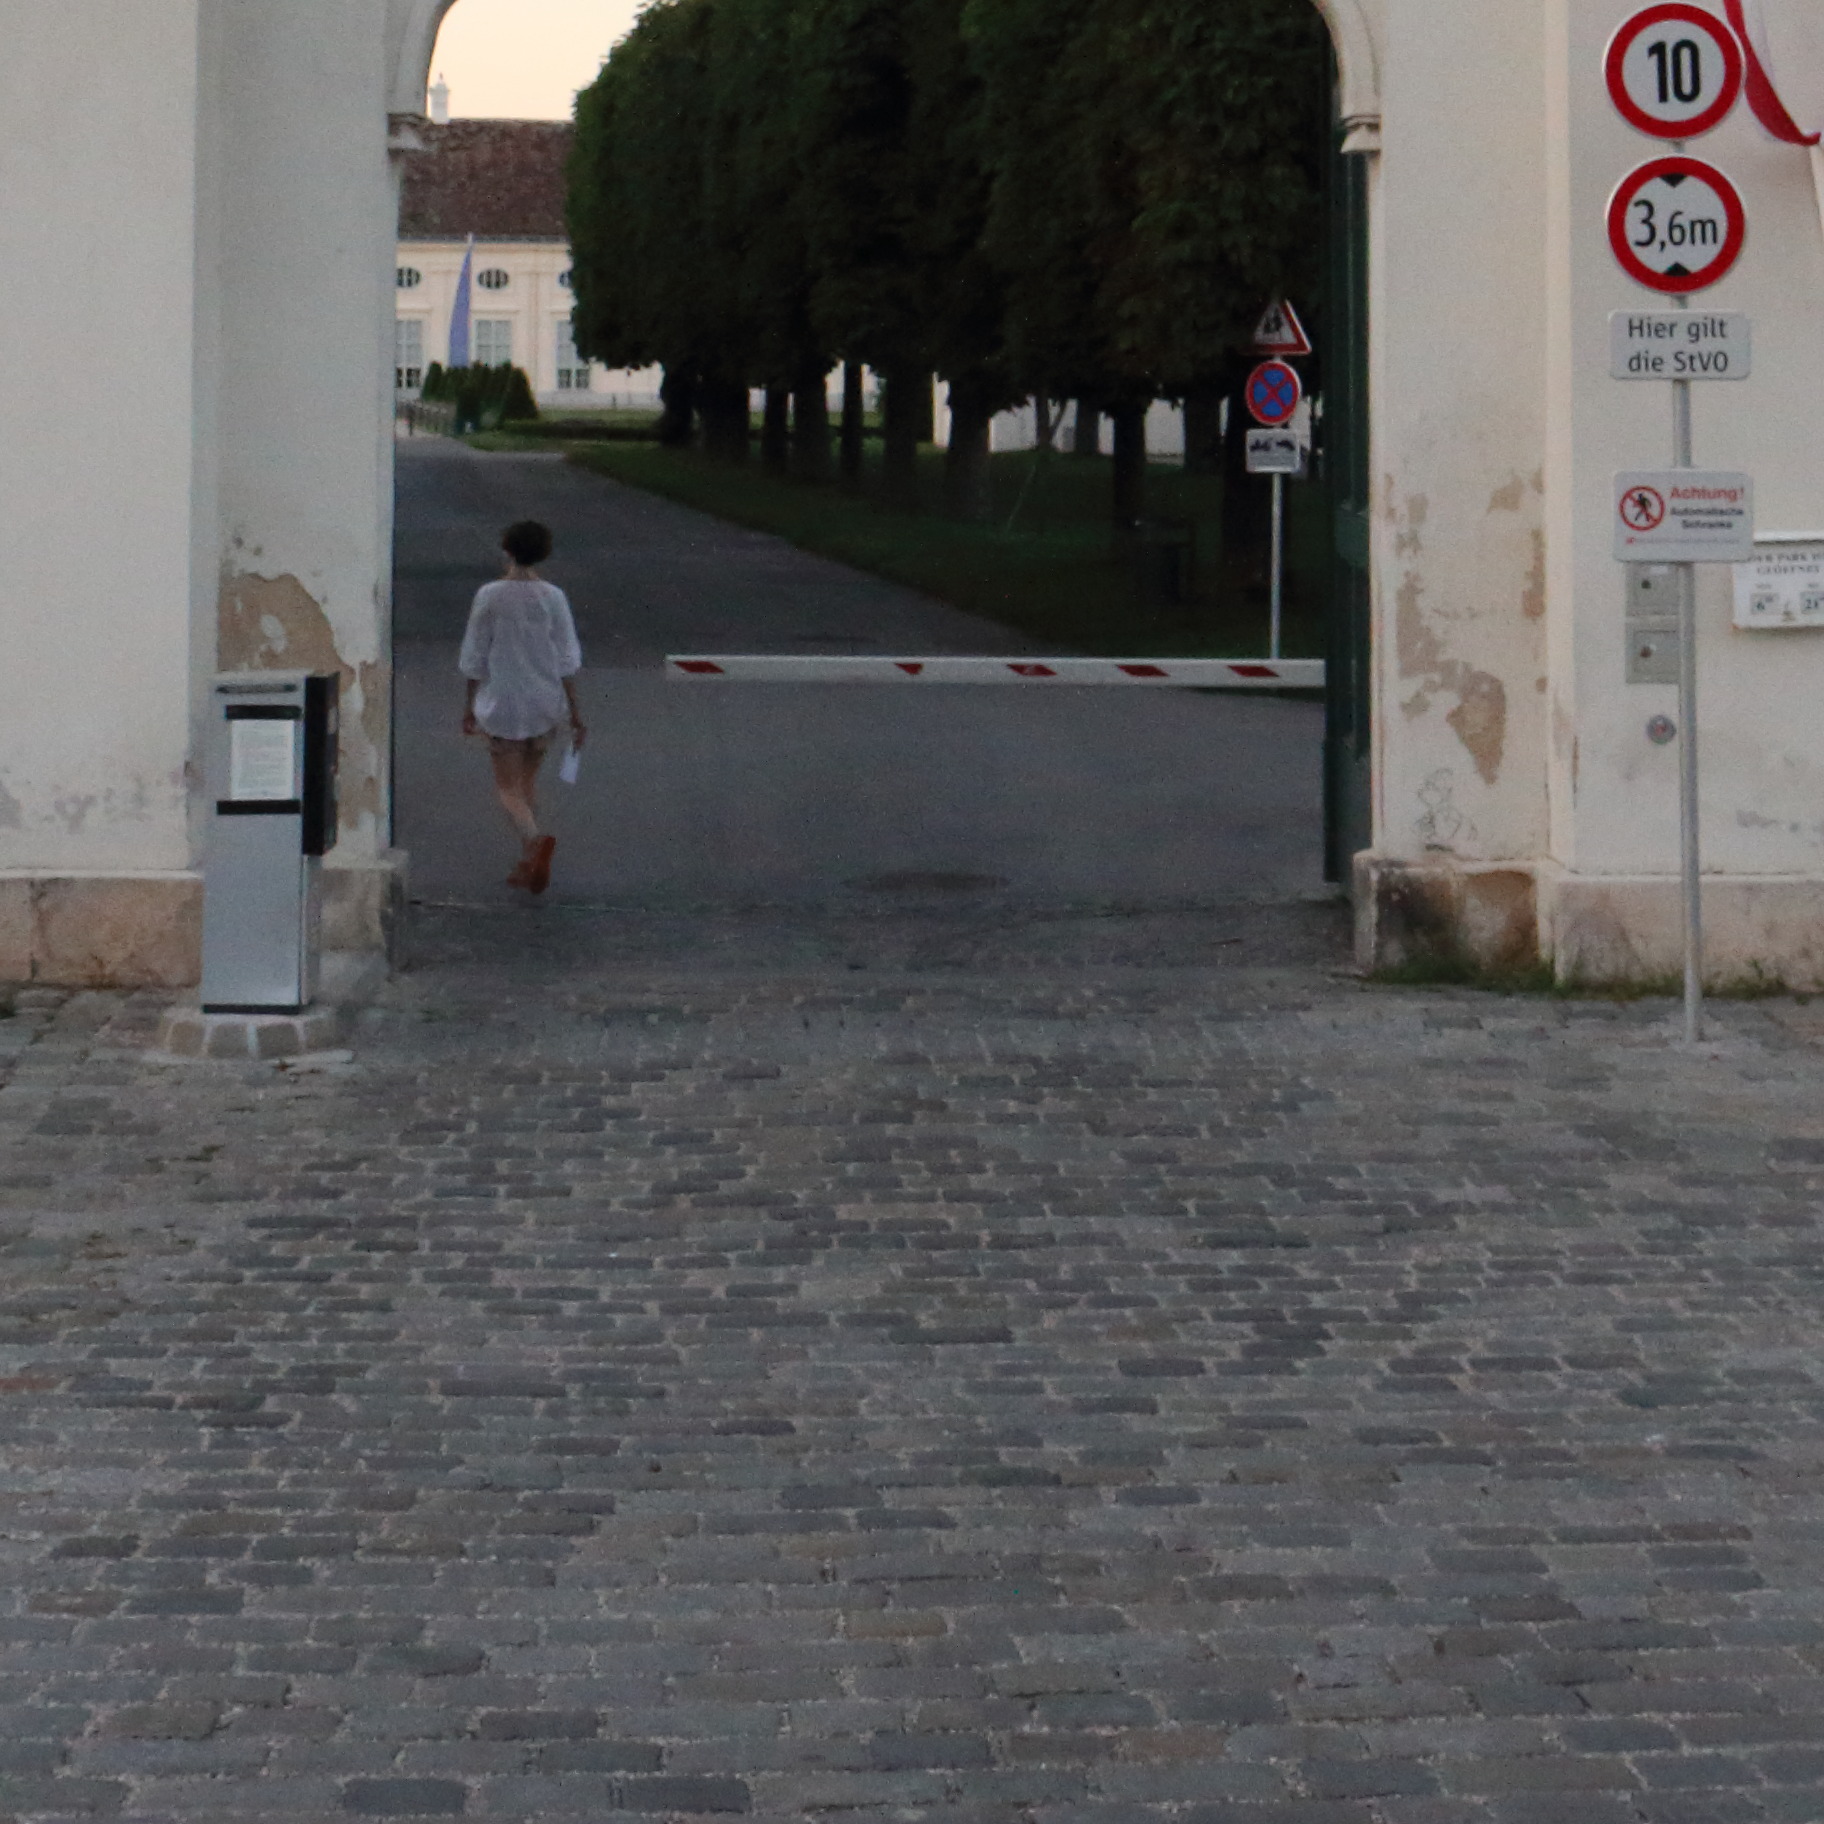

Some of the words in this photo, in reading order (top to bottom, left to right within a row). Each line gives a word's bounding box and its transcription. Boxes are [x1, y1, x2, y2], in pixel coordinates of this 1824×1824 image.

[1647, 39, 1700, 104] 10
[1632, 199, 1718, 252] 3,6m
[1628, 317, 1678, 339] Hier
[1687, 317, 1728, 344] gilt
[1628, 350, 1664, 373] die
[1673, 350, 1729, 373] StVO
[1670, 486, 1744, 503] Achtung!
